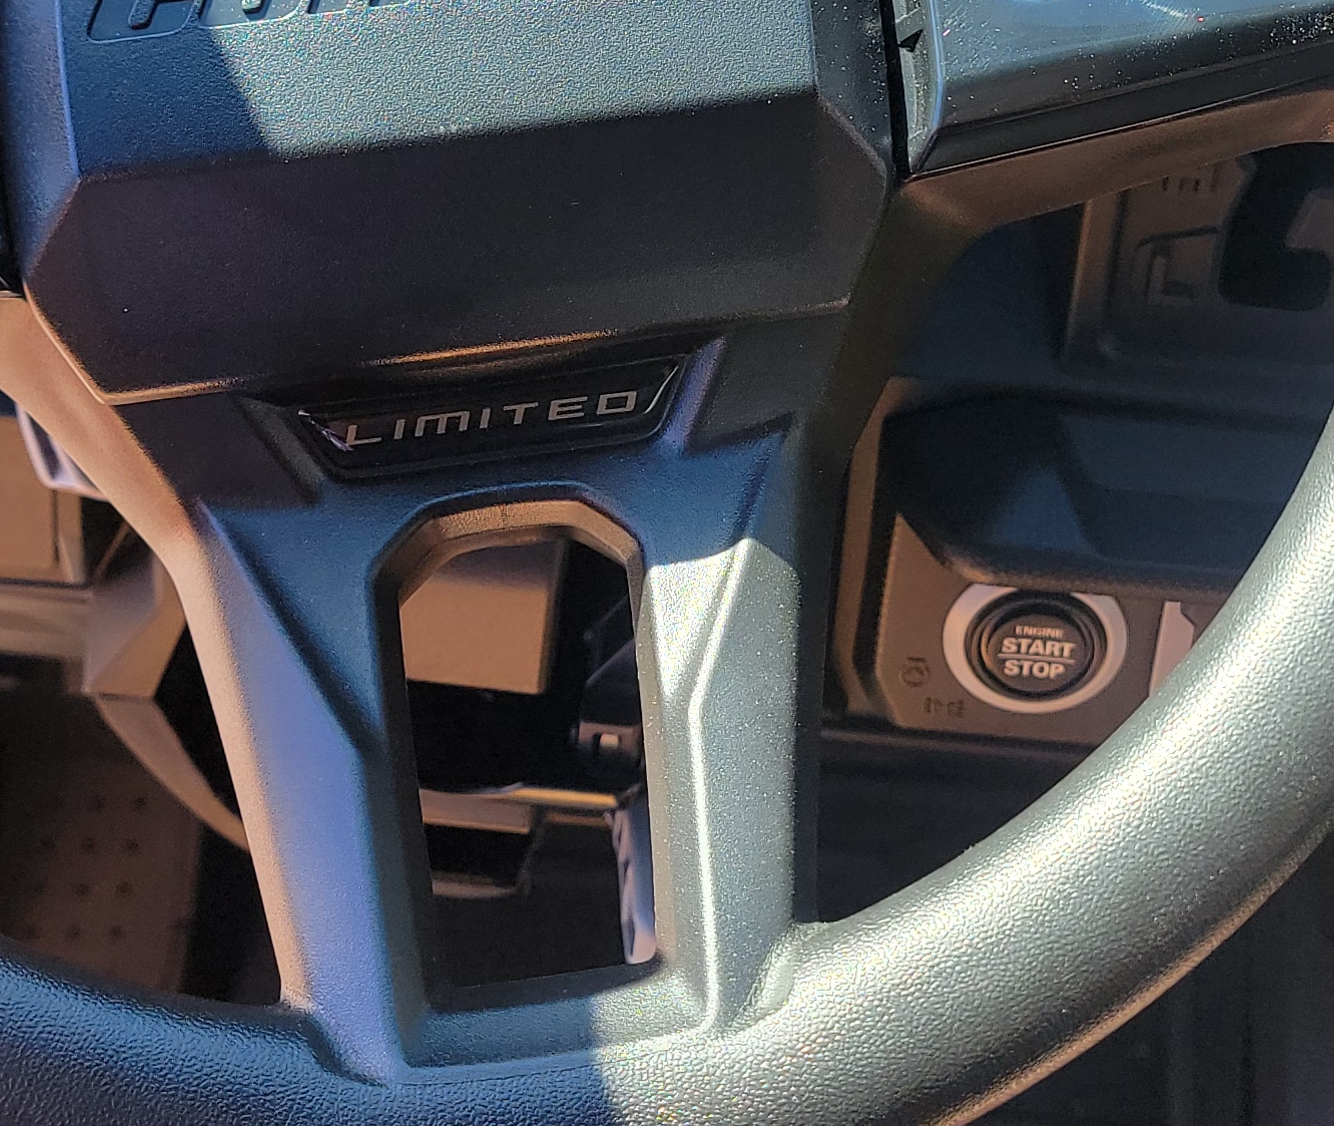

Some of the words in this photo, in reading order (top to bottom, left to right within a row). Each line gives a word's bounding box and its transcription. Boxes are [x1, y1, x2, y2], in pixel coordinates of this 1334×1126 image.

[344, 388, 641, 447] LIMITED
[1015, 625, 1064, 638] ENGINE
[1002, 636, 1076, 657] START
[1004, 659, 1066, 679] STOP
